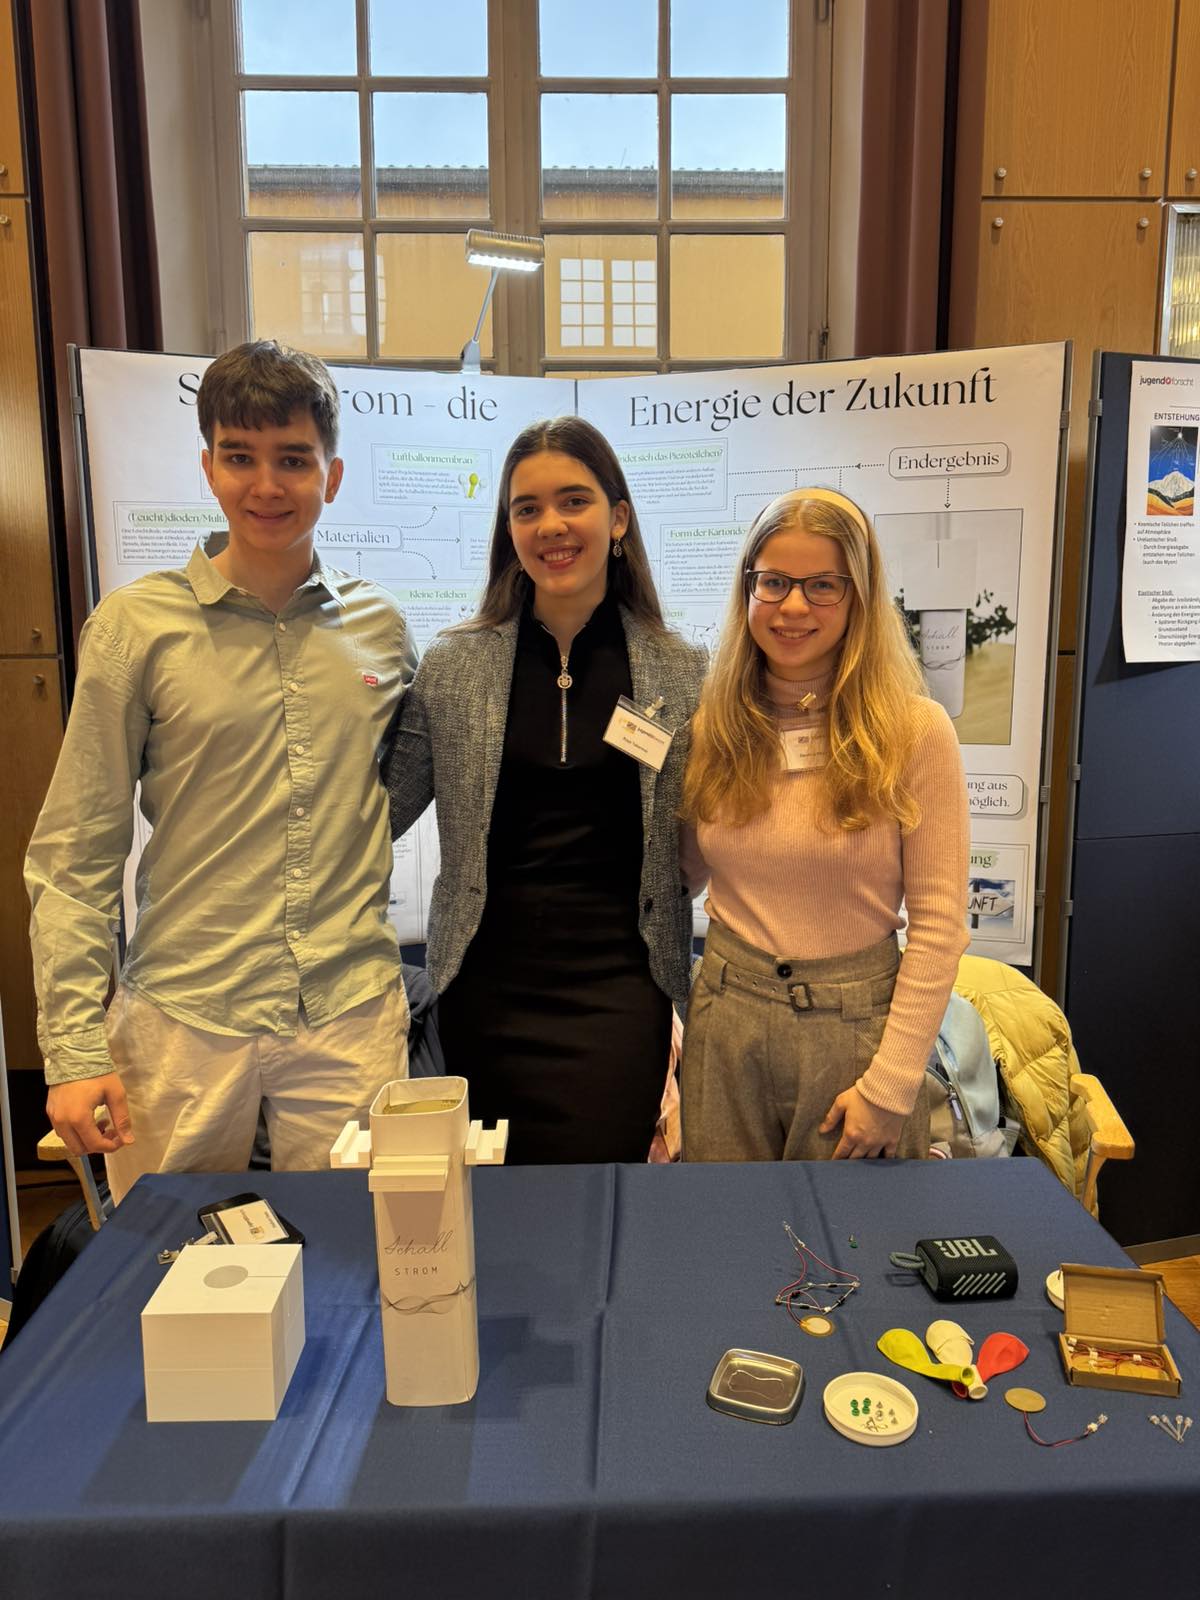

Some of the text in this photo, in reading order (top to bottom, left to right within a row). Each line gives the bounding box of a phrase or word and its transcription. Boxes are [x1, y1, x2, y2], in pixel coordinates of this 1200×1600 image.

[447, 386, 498, 421] die
[631, 367, 998, 431] Energie der Zukunft
[1154, 412, 1200, 421] ENTSTEHUNG
[898, 452, 1000, 472] Endergebnis
[317, 529, 390, 544] Materialien
[670, 529, 693, 538] Form
[693, 528, 706, 537] der
[409, 590, 435, 599] Kleine
[987, 782, 1008, 791] aus
[384, 1229, 454, 1256] Schall
[934, 1238, 999, 1259] JBL
[394, 1266, 438, 1277] STROM
